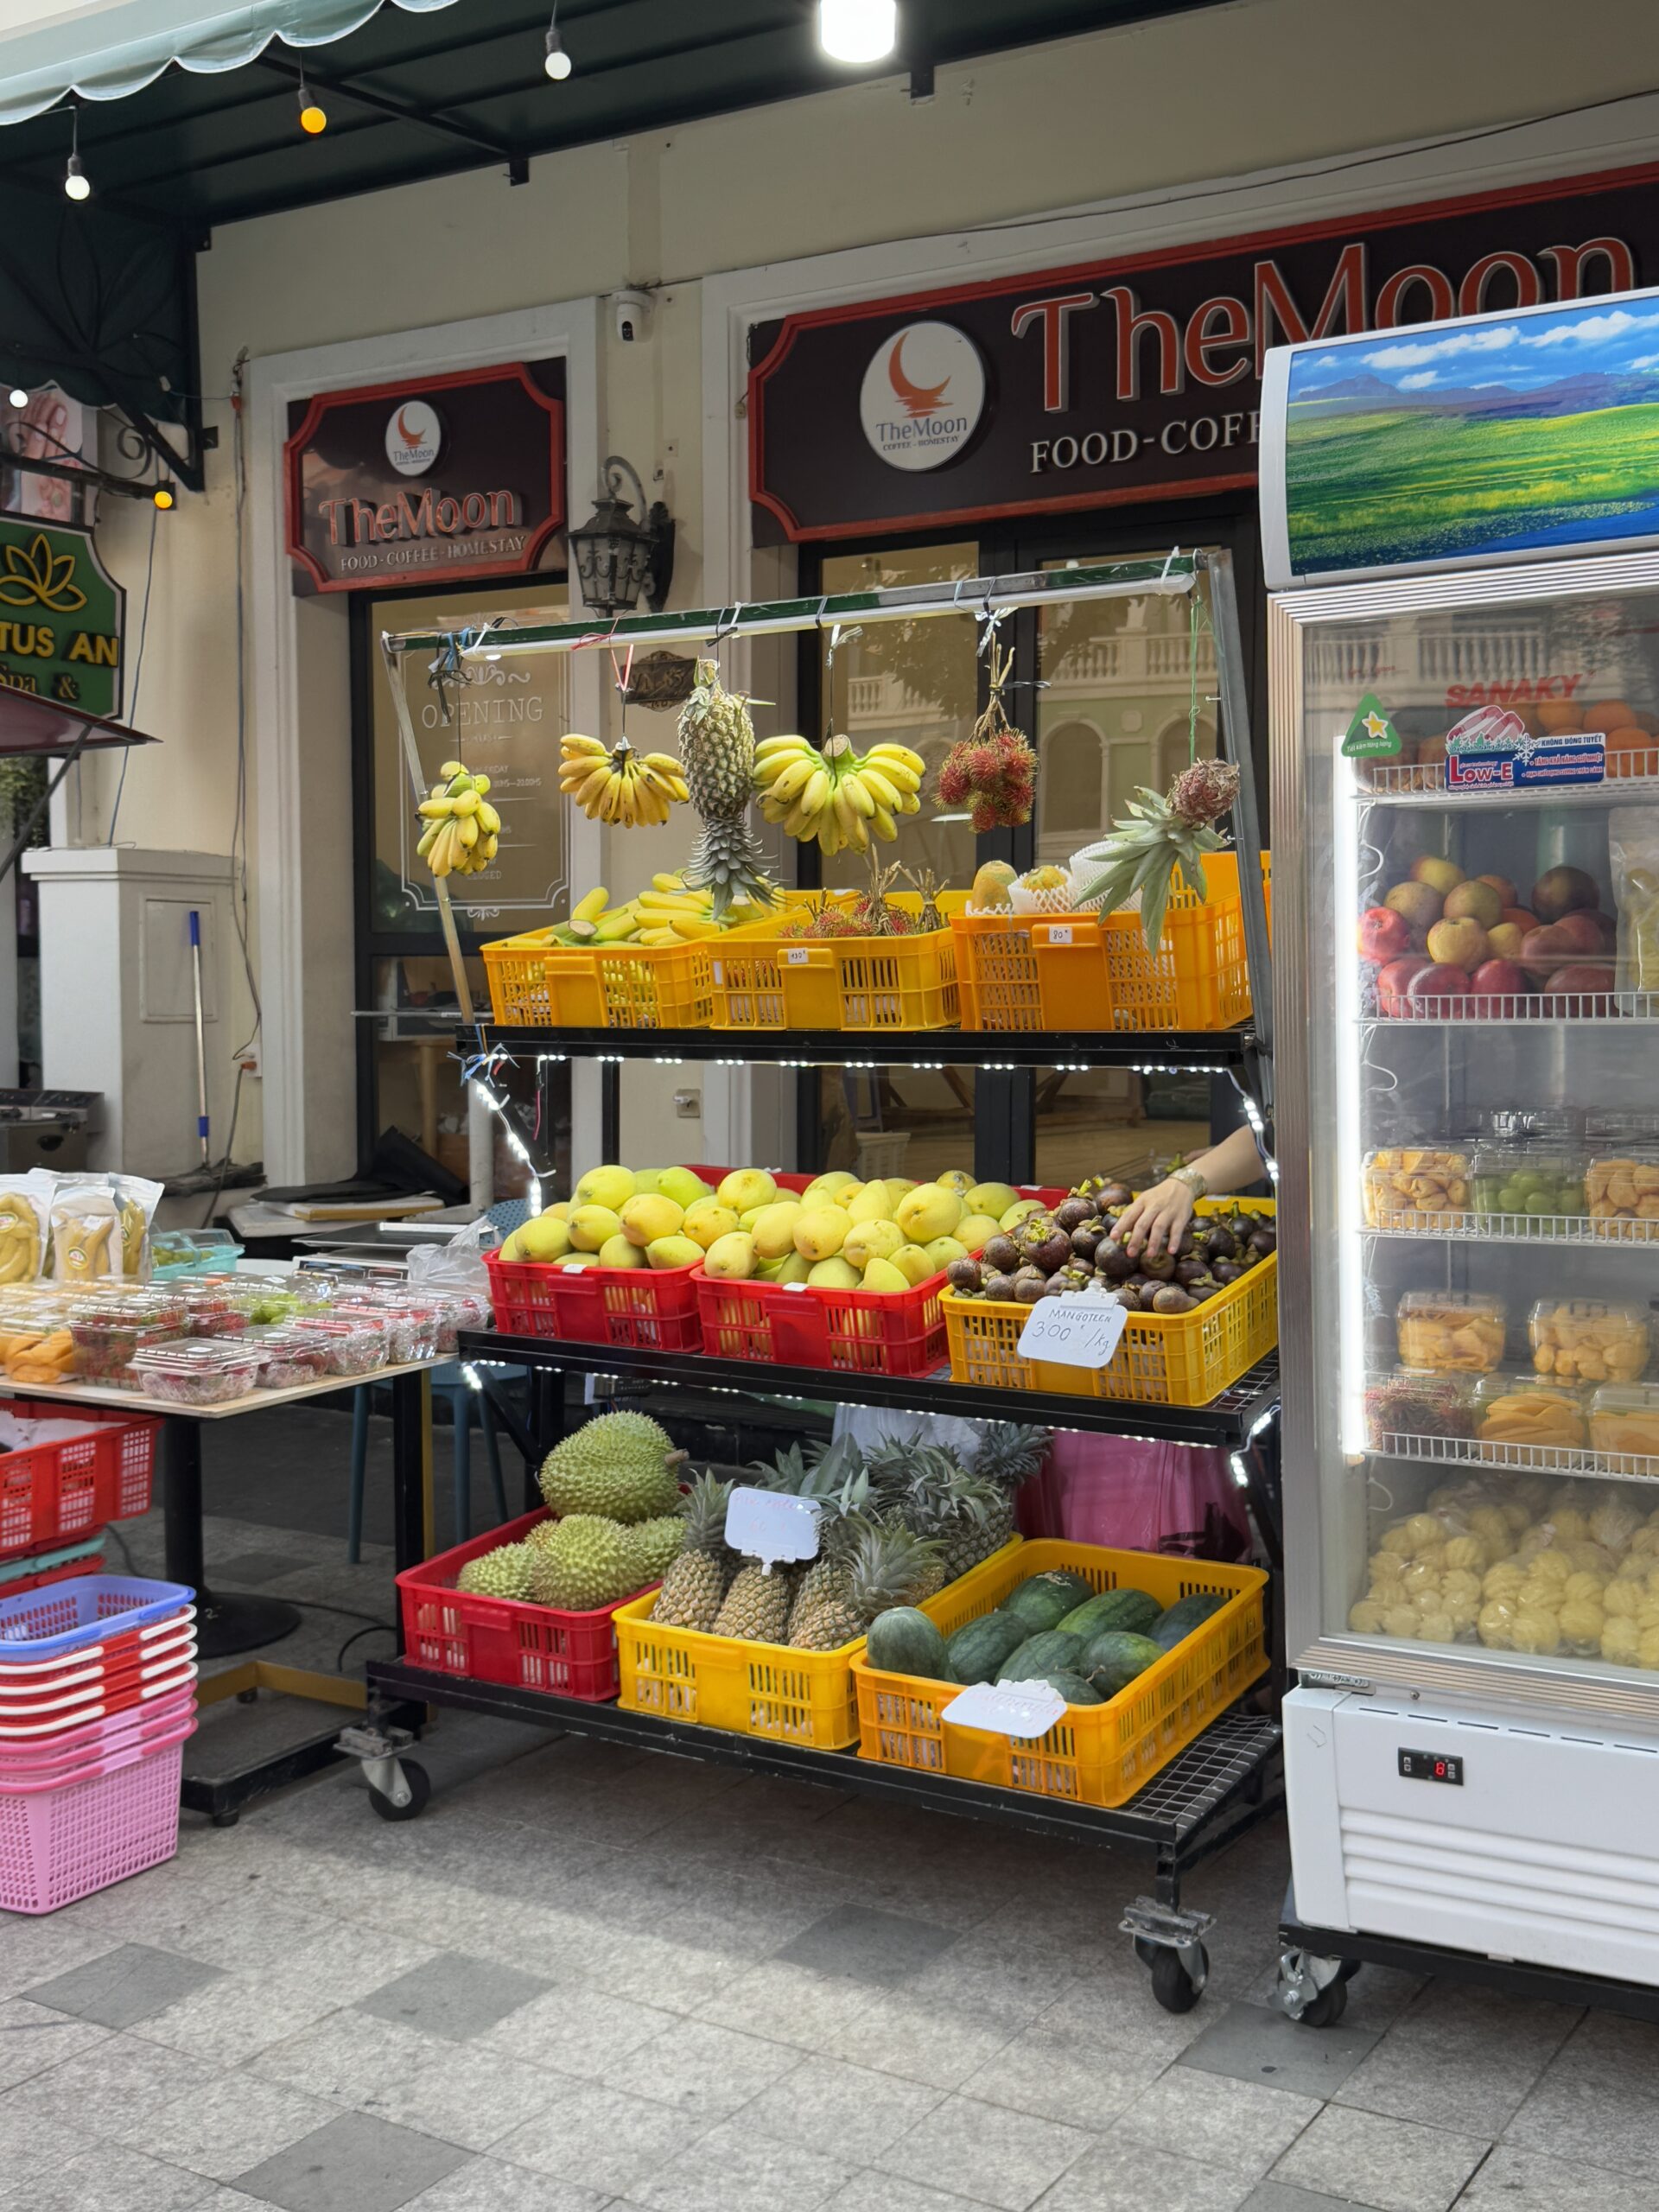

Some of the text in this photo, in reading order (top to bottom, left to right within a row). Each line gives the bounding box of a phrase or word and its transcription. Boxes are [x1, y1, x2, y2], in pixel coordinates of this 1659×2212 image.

[876, 416, 967, 442] TheMoon
[318, 487, 517, 546] TheMoon
[341, 554, 378, 572] FOOD
[386, 544, 439, 567] COFFEE
[448, 535, 526, 560] HOMESTAY
[68, 632, 119, 668] AN
[58, 675, 77, 699] &
[1446, 673, 1583, 709] SANAKY
[421, 696, 543, 729] OPENING
